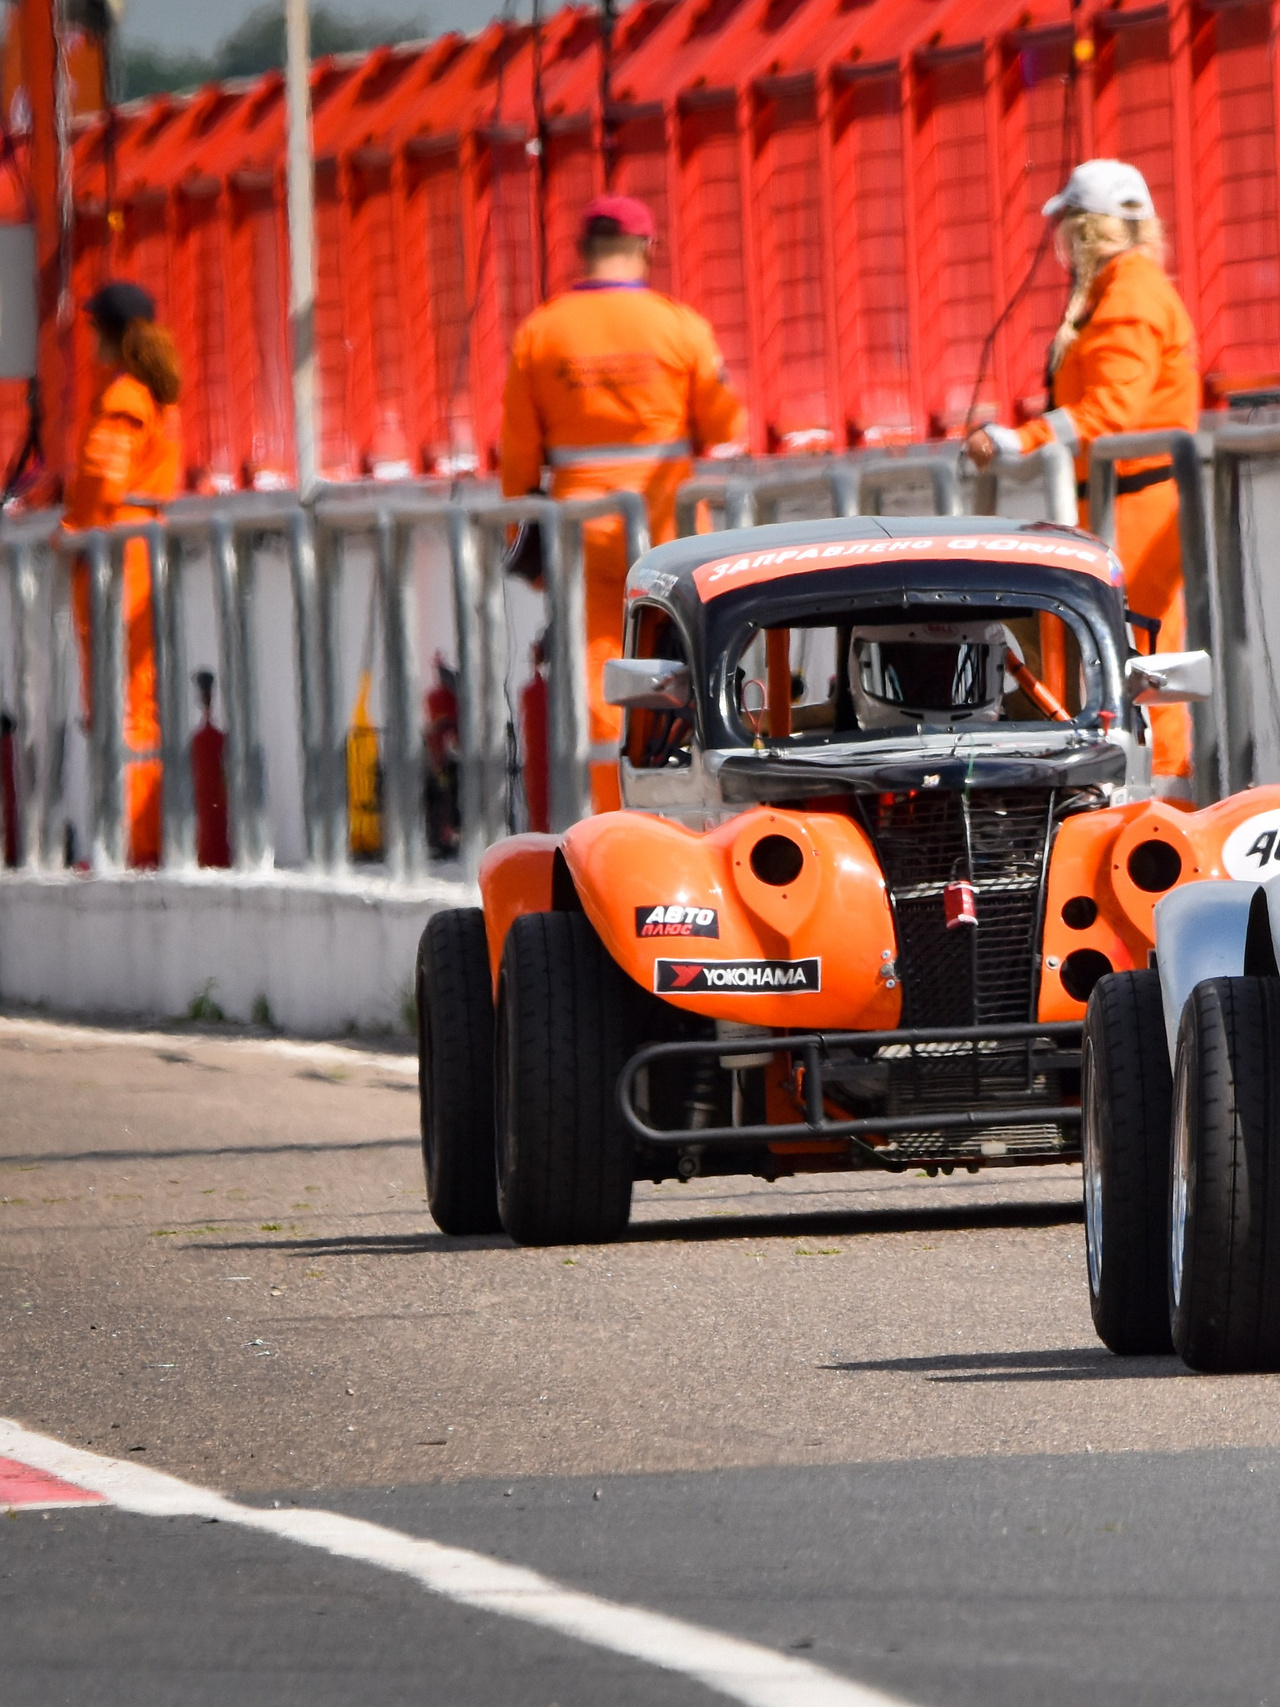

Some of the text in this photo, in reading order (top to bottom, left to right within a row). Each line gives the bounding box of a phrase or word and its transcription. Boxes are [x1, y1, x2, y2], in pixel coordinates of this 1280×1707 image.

[708, 539, 933, 582] ЗАПРАВЛЕНО
[645, 904, 716, 927] АВТО
[641, 922, 694, 937] ПЛЮС
[702, 966, 808, 987] YOKOHAMA
